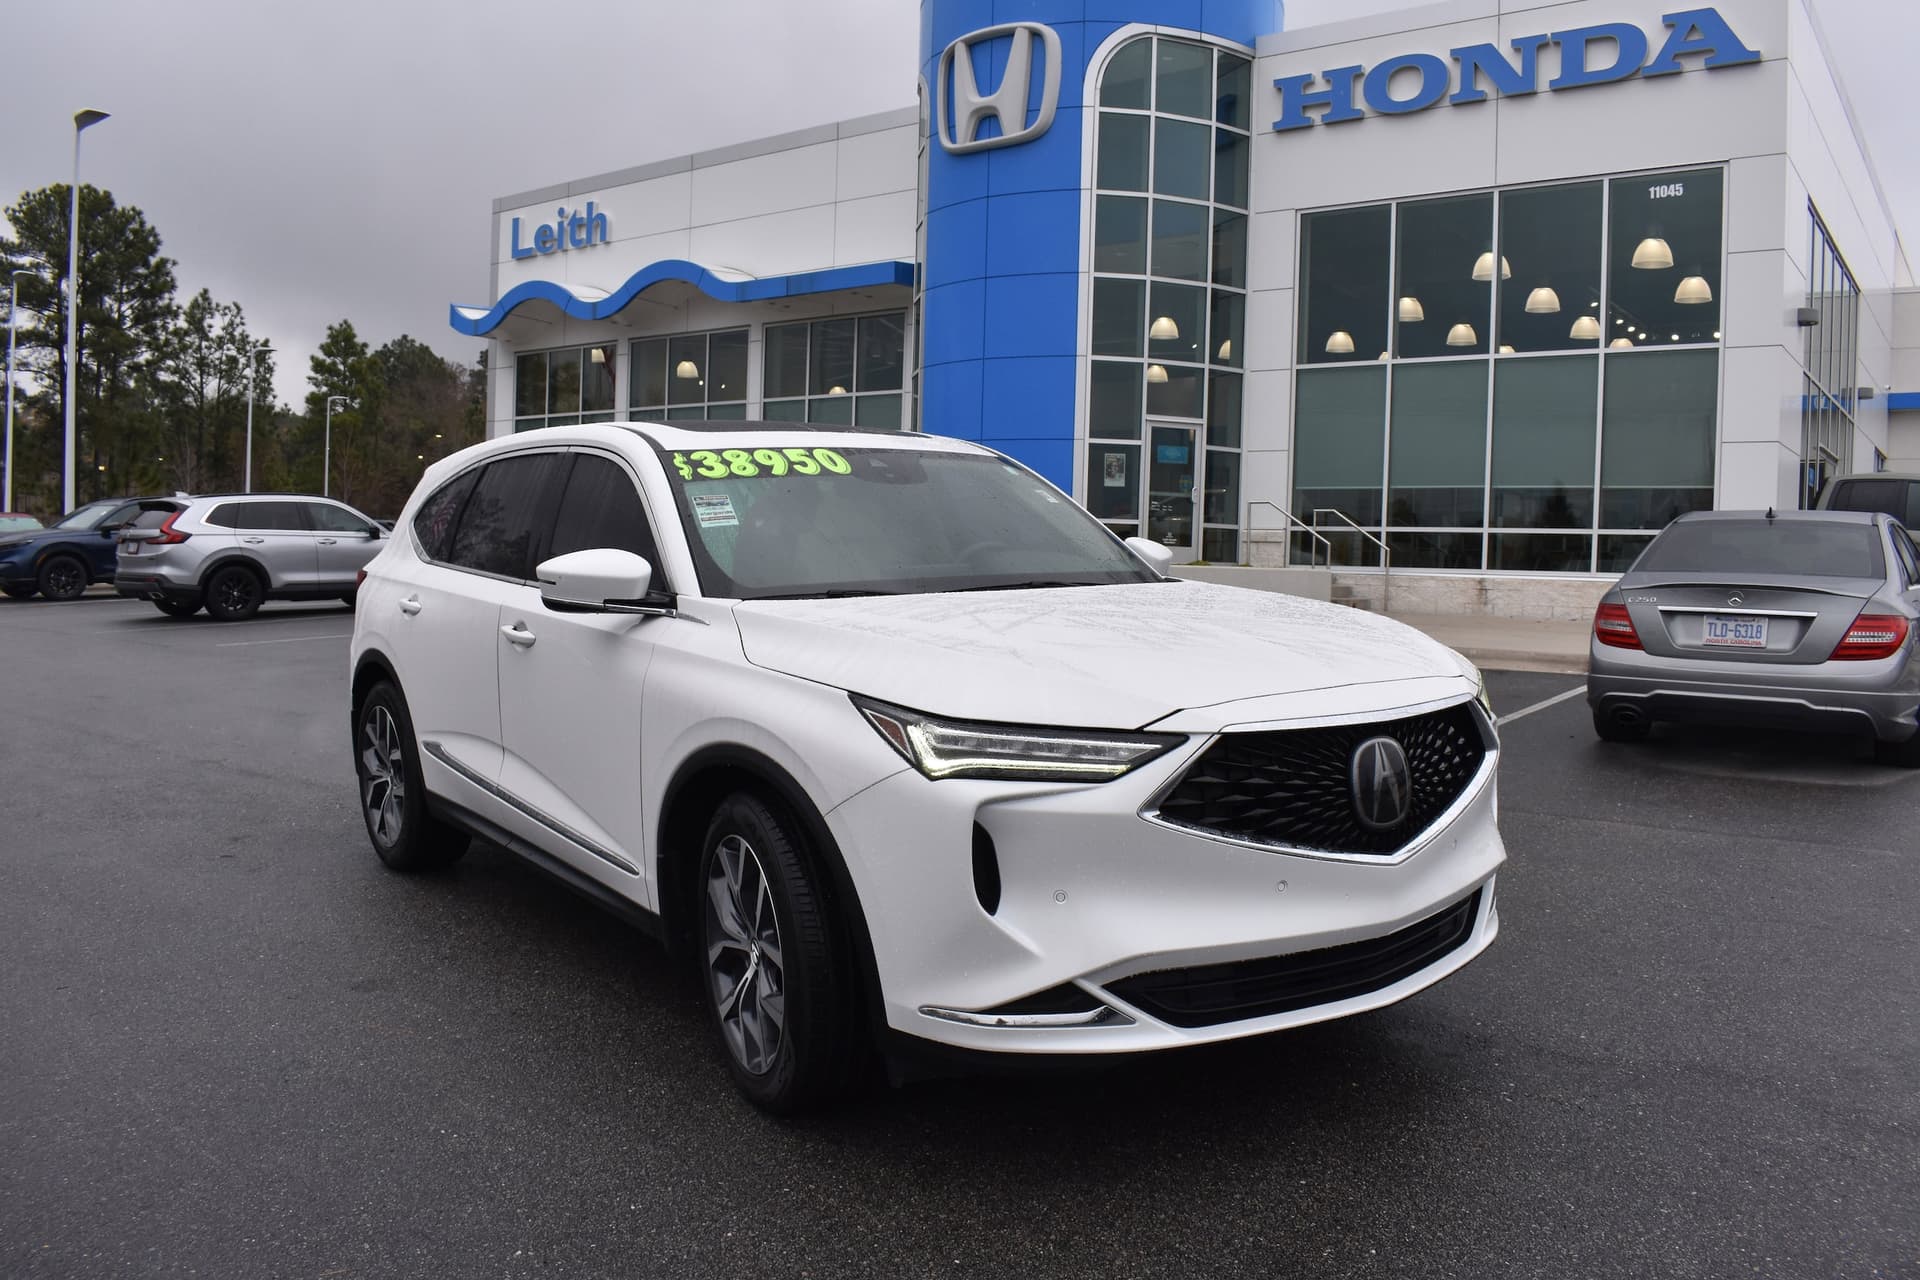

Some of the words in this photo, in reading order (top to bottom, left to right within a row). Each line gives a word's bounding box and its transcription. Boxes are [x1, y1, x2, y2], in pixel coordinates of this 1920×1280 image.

[1272, 7, 1761, 132] HONDA
[1648, 183, 1684, 199] 11045
[511, 201, 608, 259] Leith
[673, 448, 852, 481] $38950
[1707, 622, 1763, 639] TLD-6318
